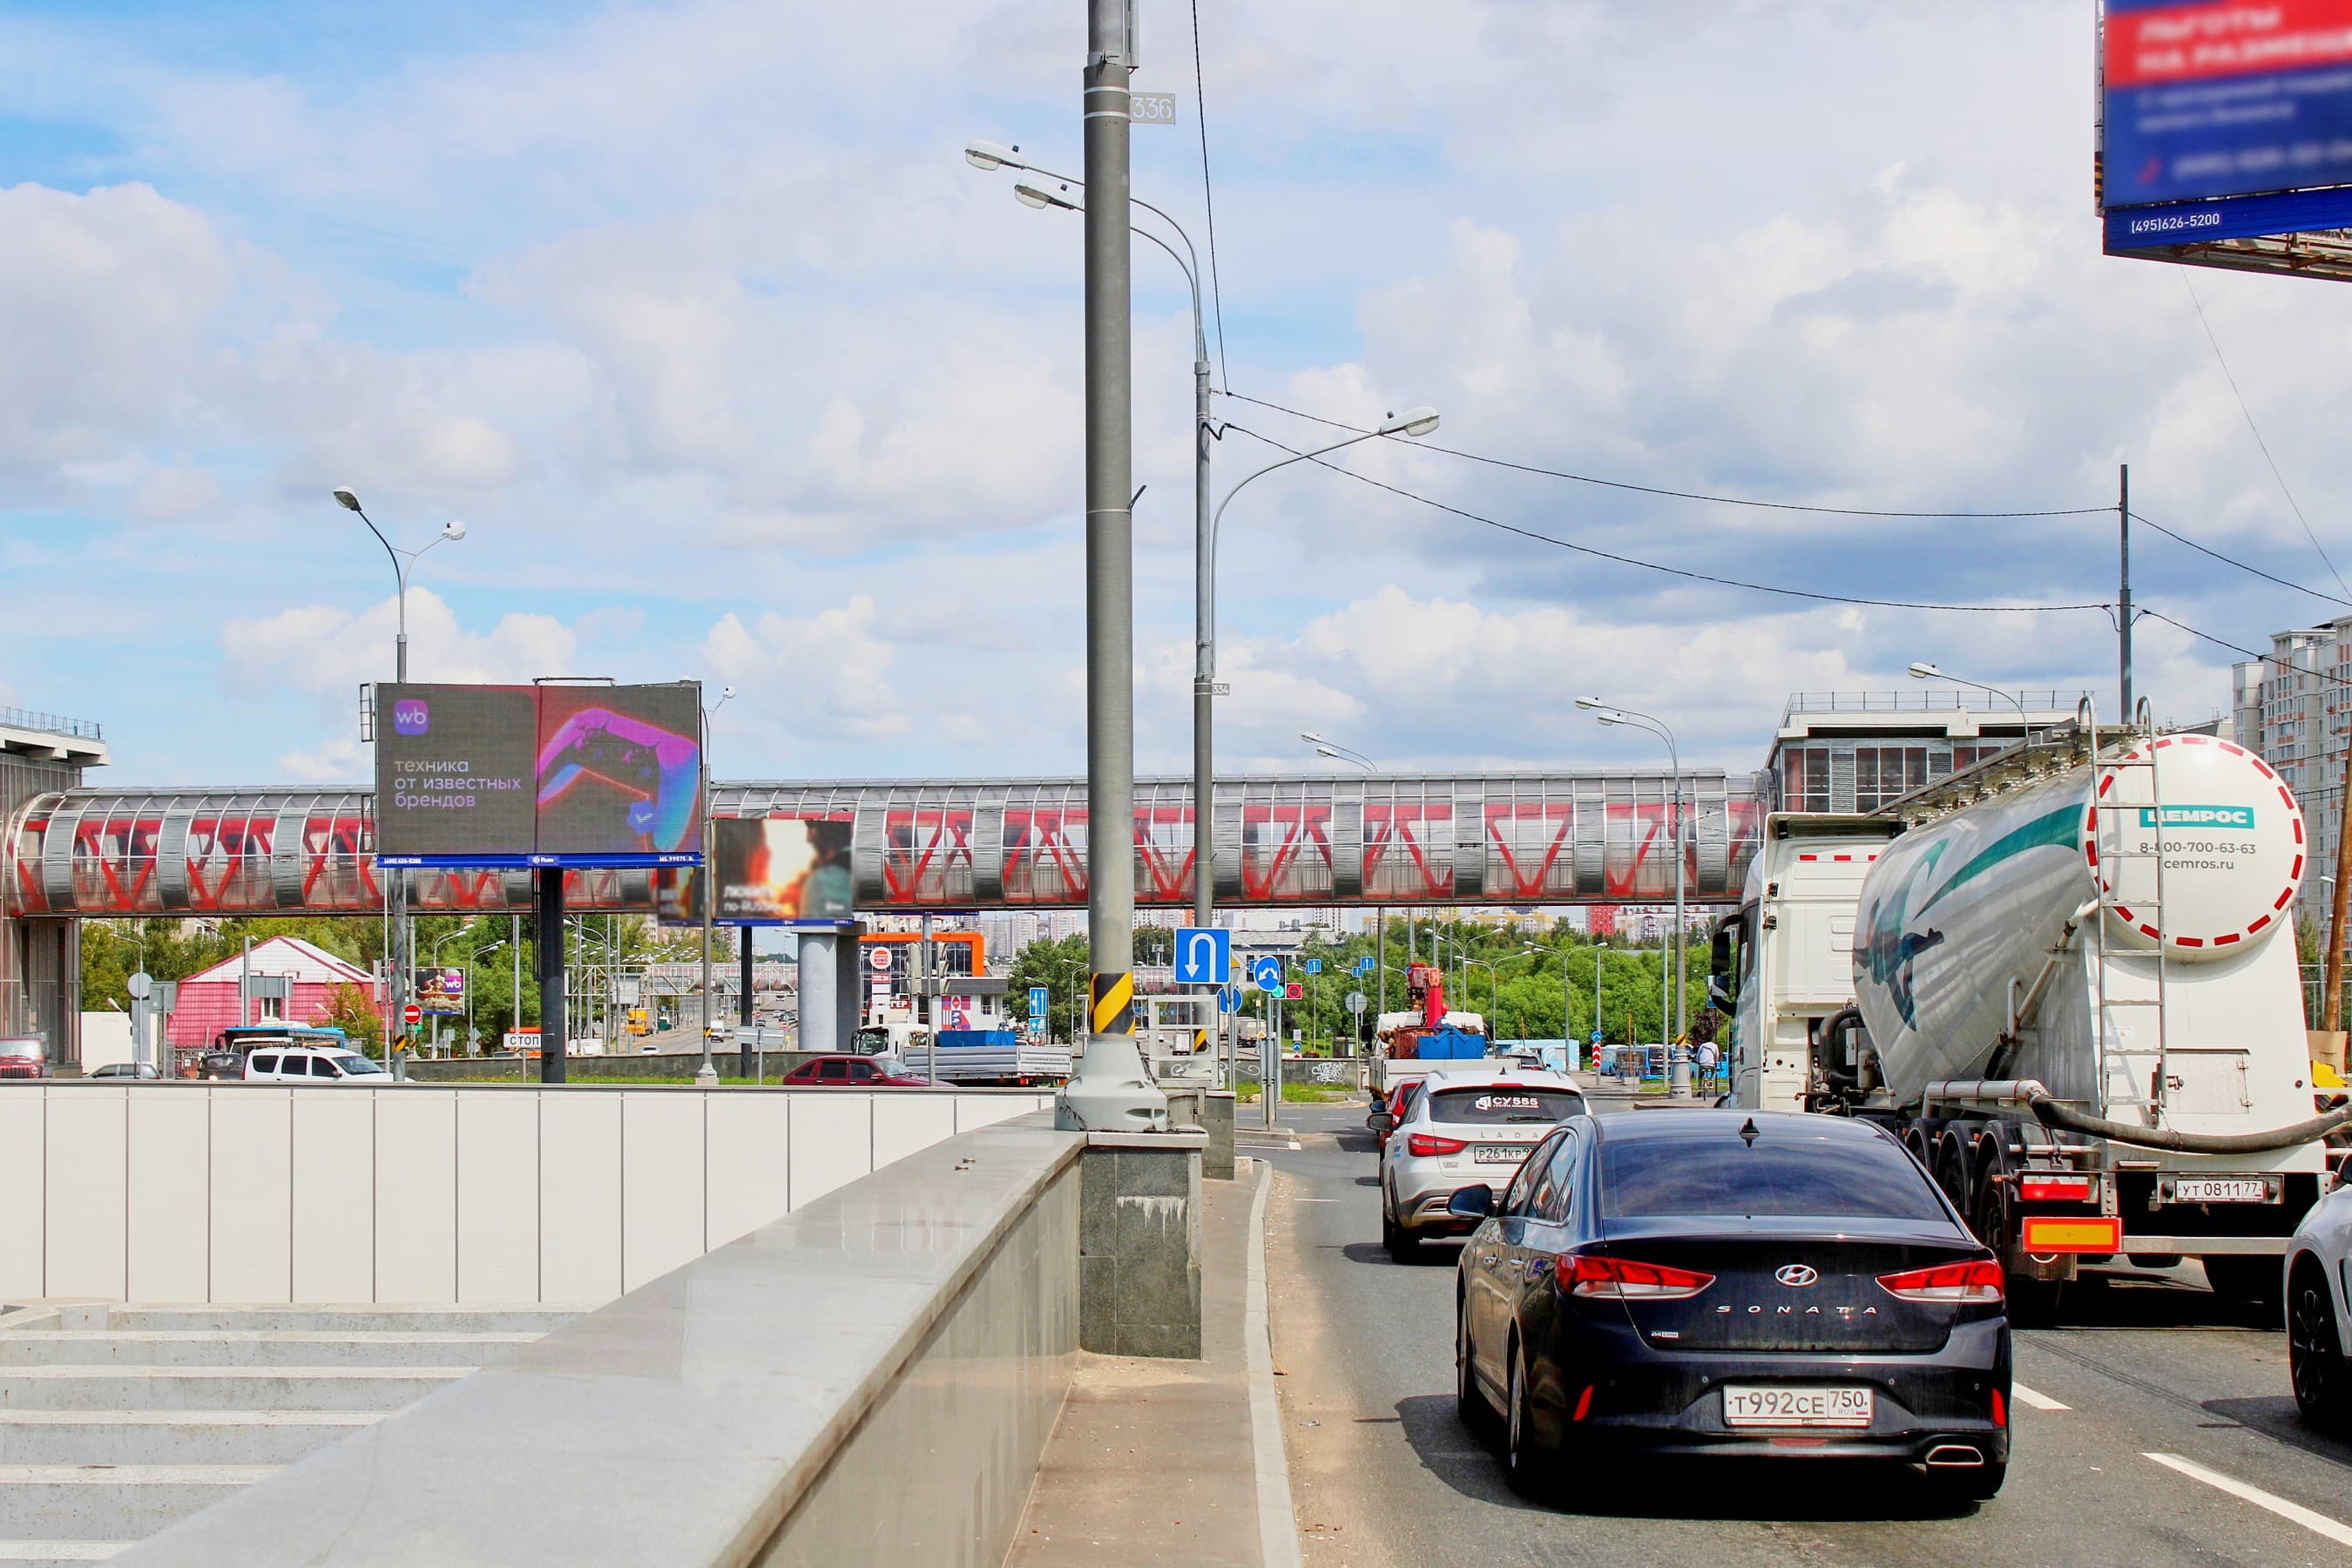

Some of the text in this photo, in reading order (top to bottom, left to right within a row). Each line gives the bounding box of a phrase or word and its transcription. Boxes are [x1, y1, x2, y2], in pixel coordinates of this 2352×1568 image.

[1132, 97, 1172, 119] 336
[2132, 213, 2220, 234] (495)626-5200
[396, 706, 426, 725] wb
[394, 760, 470, 773] техника
[395, 778, 522, 790] от известных
[395, 791, 476, 809] брендов
[2164, 860, 2234, 869] cemros.ru
[445, 979, 462, 989] wb
[510, 1036, 539, 1045] СТОП
[1717, 1306, 1876, 1315] SONATA
[1829, 1391, 1864, 1409] 750
